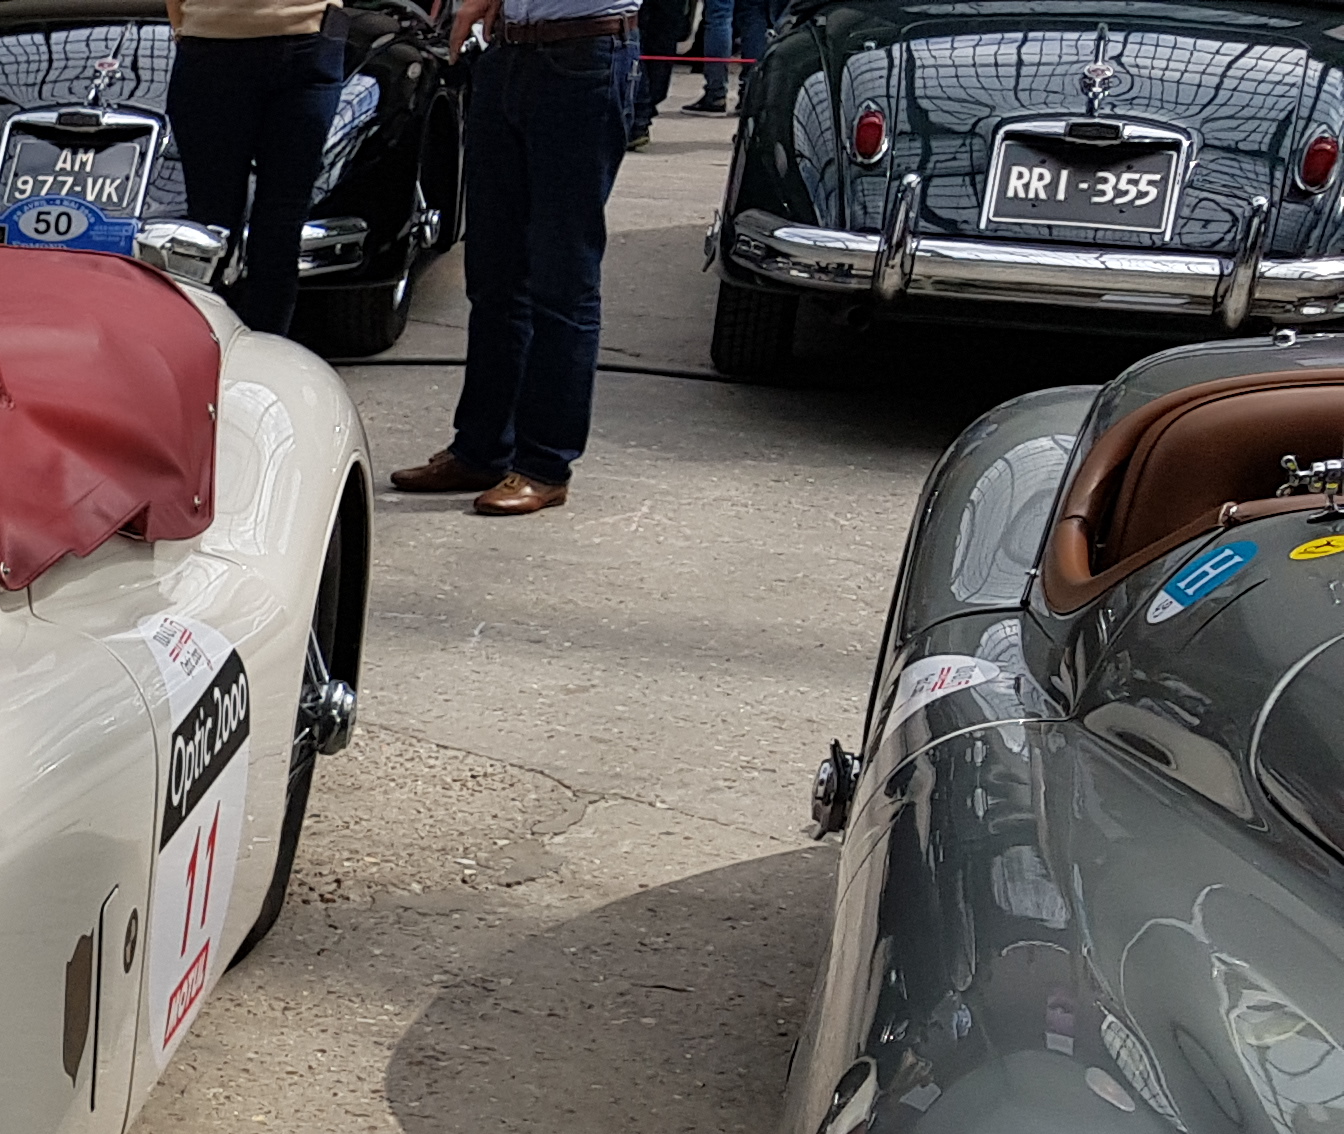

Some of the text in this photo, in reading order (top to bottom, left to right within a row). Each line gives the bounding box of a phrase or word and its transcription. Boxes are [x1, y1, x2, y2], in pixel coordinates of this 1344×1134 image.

[54, 148, 96, 173] AM
[14, 175, 122, 203] 977-VK
[33, 210, 72, 236] 50
[1176, 548, 1244, 596] H
[171, 672, 247, 817] Optic 2000
[180, 800, 221, 959] 11
